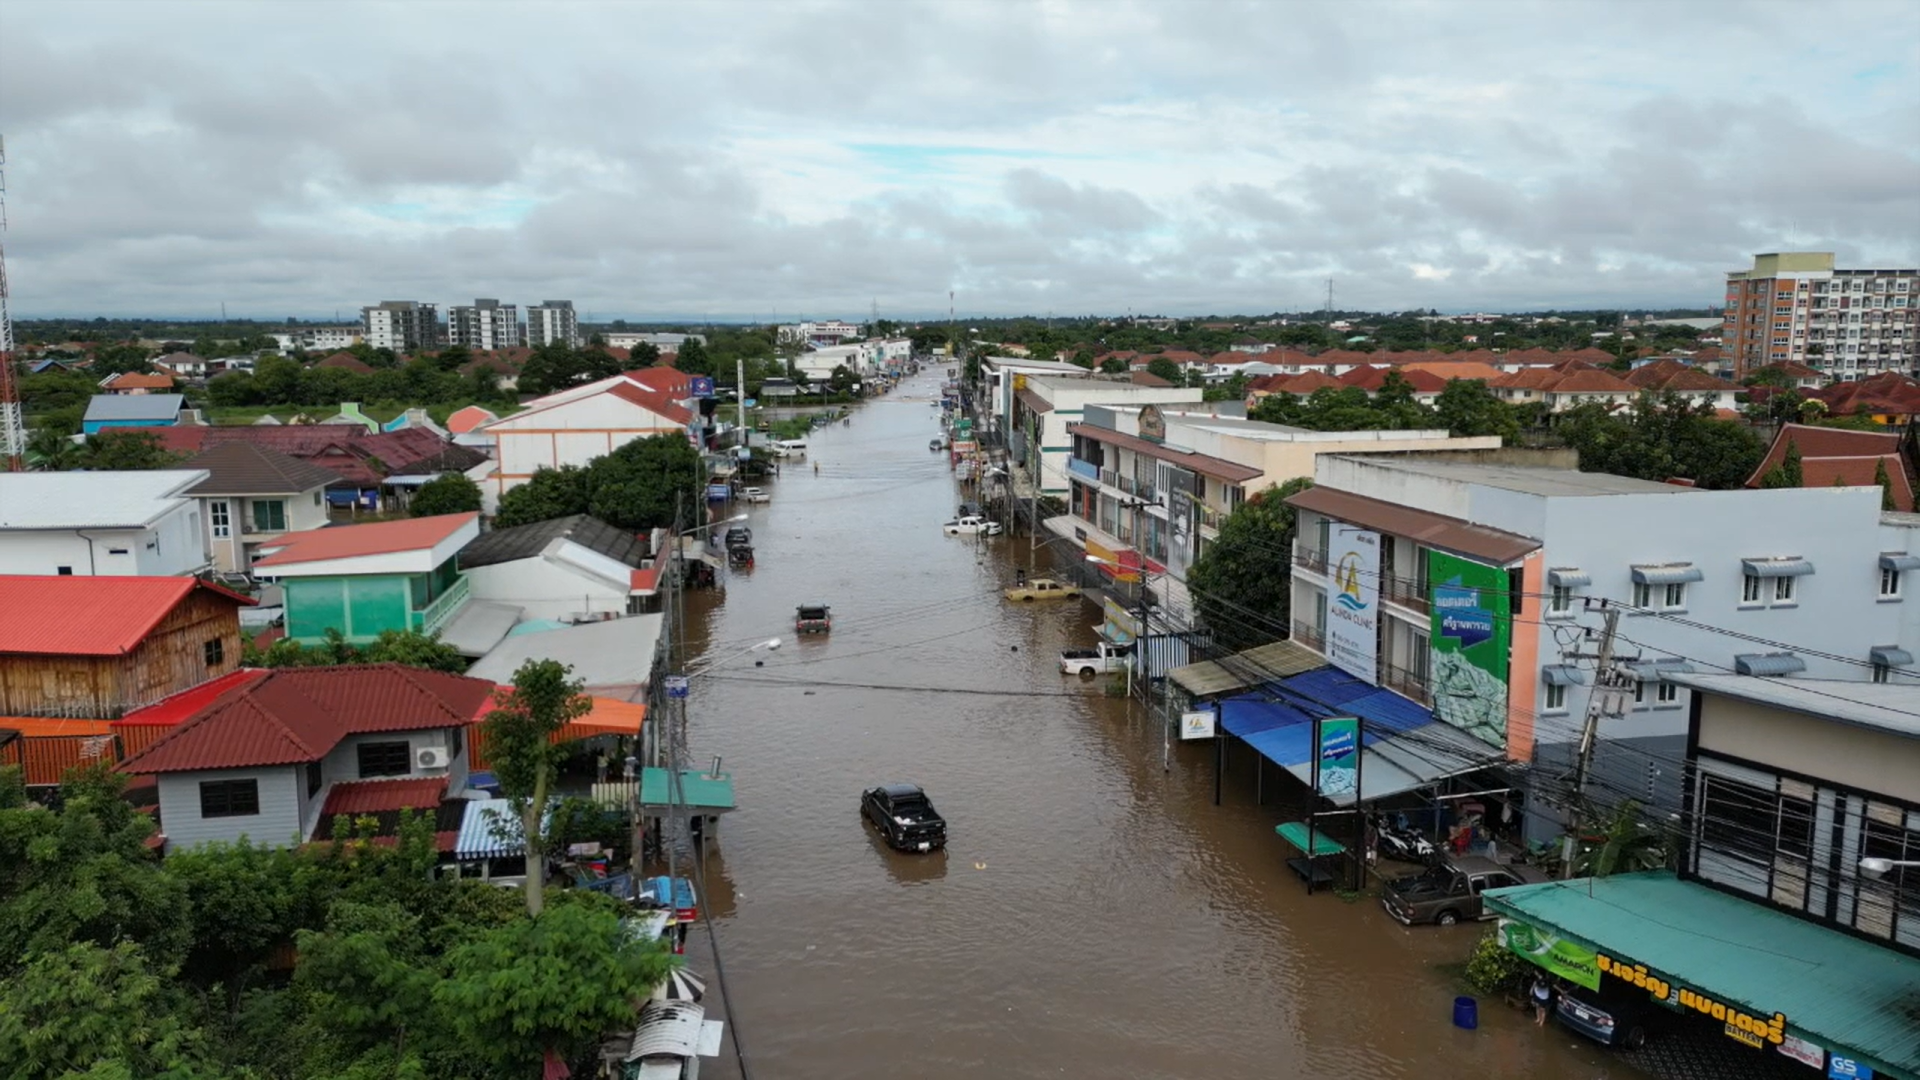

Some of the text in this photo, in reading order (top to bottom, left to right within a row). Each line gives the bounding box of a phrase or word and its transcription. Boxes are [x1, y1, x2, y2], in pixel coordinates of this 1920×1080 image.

[1353, 613, 1373, 631] CLINIC
[1553, 953, 1595, 977] AMARON
[1680, 988, 1784, 1045] แบตเตอรี่
[1726, 1025, 1763, 1045] BATTERY
[1831, 1056, 1857, 1073] GS
